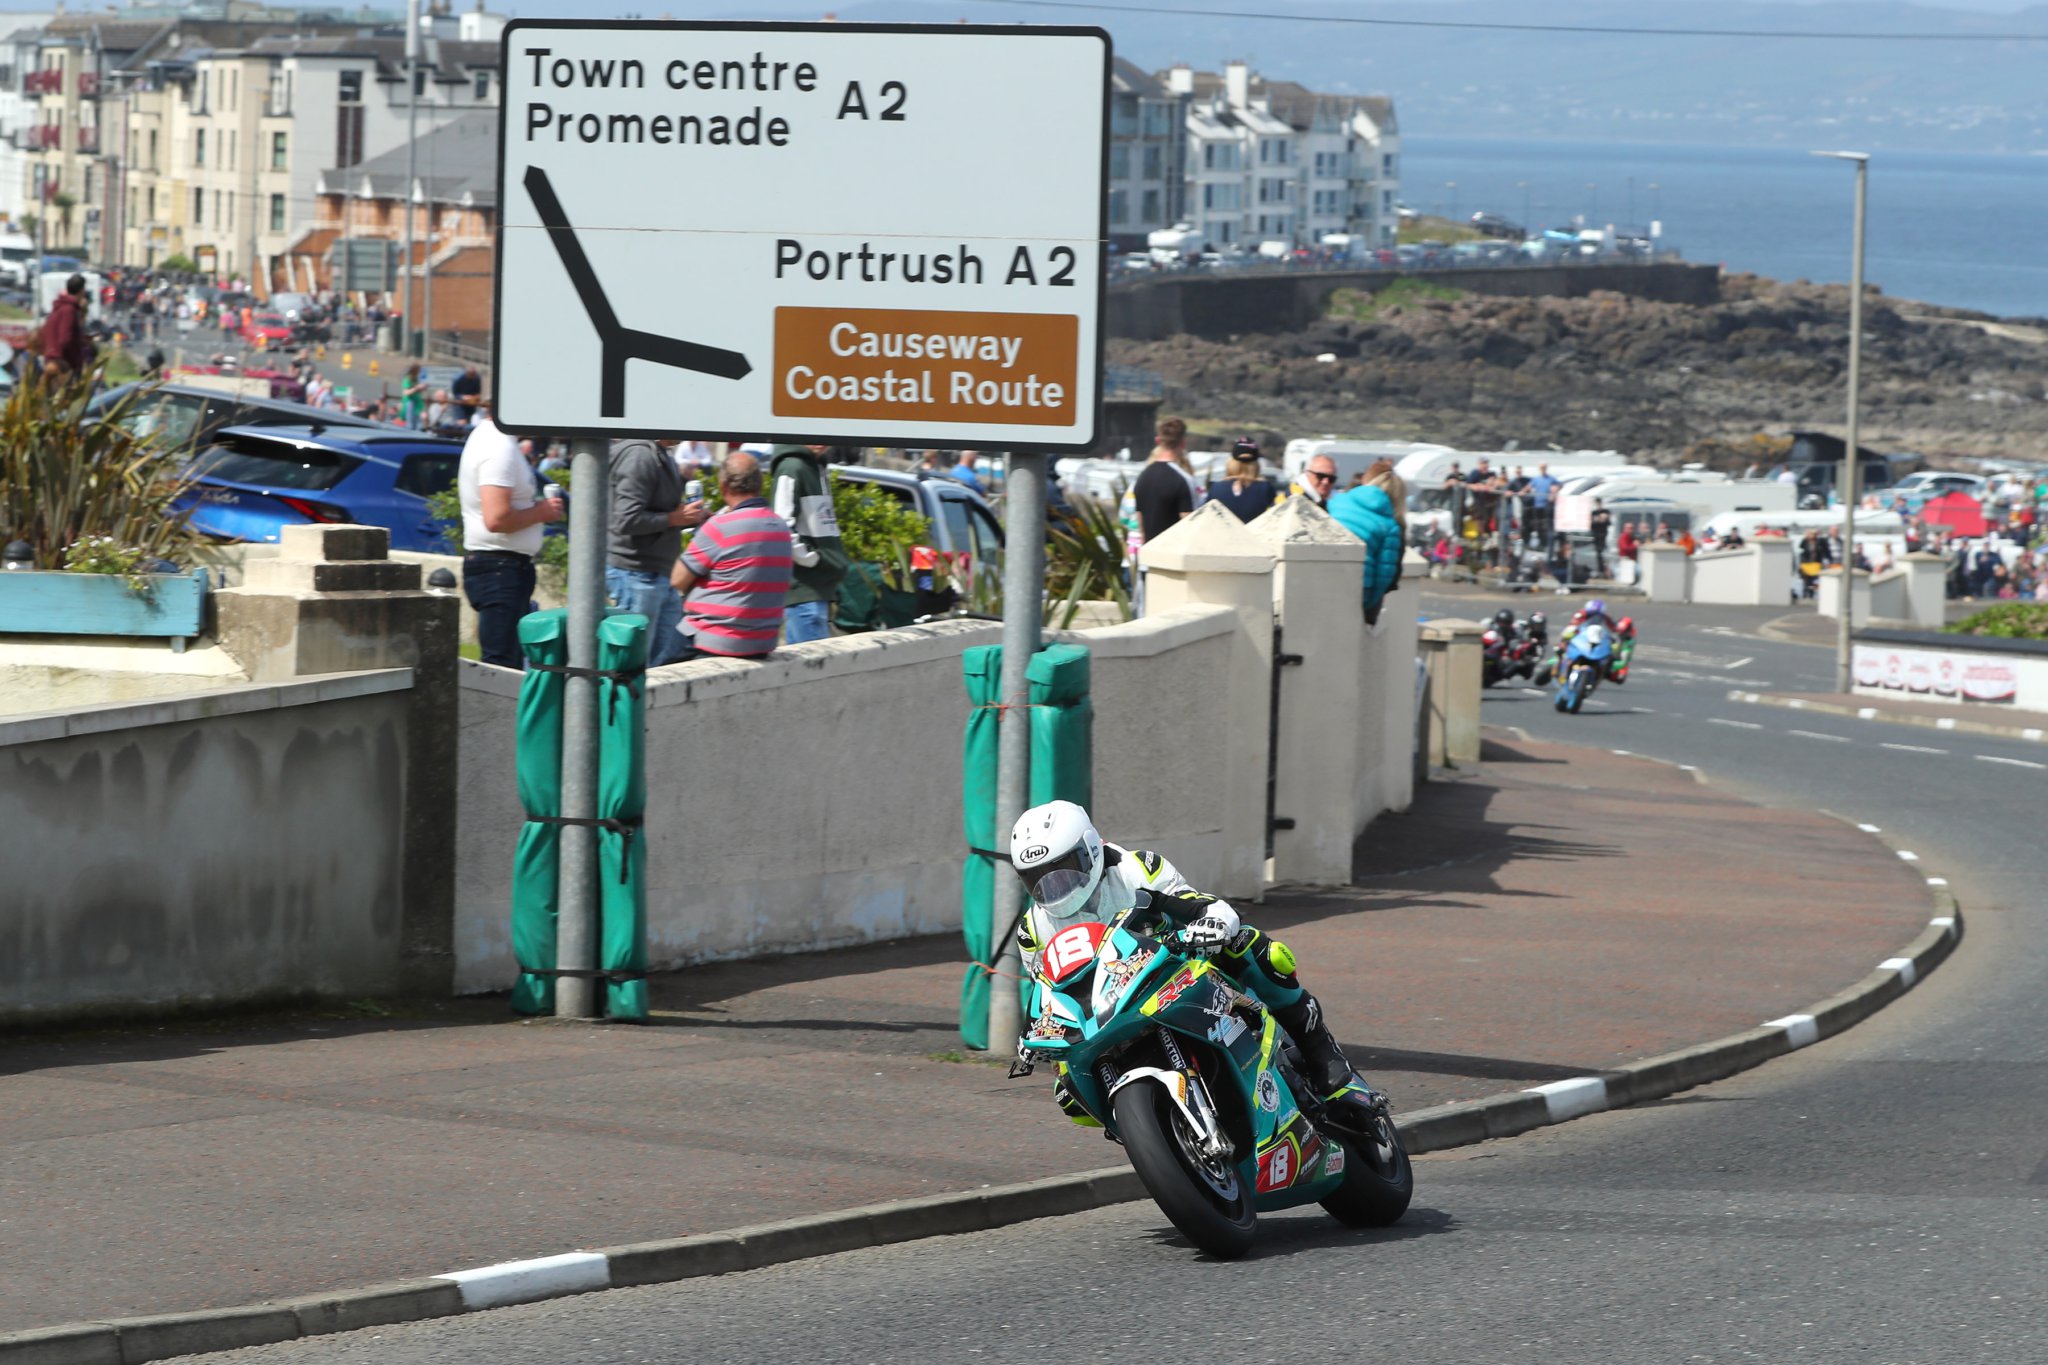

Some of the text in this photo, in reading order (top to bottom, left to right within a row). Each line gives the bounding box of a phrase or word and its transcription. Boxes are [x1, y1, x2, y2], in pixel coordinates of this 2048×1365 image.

[525, 47, 818, 92] Town centre
[837, 80, 907, 121] A2
[526, 102, 790, 147] Promenade
[775, 239, 1076, 287] Portrush A2
[829, 322, 1022, 367] Causeway
[786, 365, 1064, 408] Coastal Route
[1023, 848, 1044, 859] Arai
[1046, 927, 1095, 980] 18
[1157, 967, 1198, 1011] RR
[1160, 1027, 1182, 1070] MAXTON
[1269, 1145, 1289, 1187] 18
